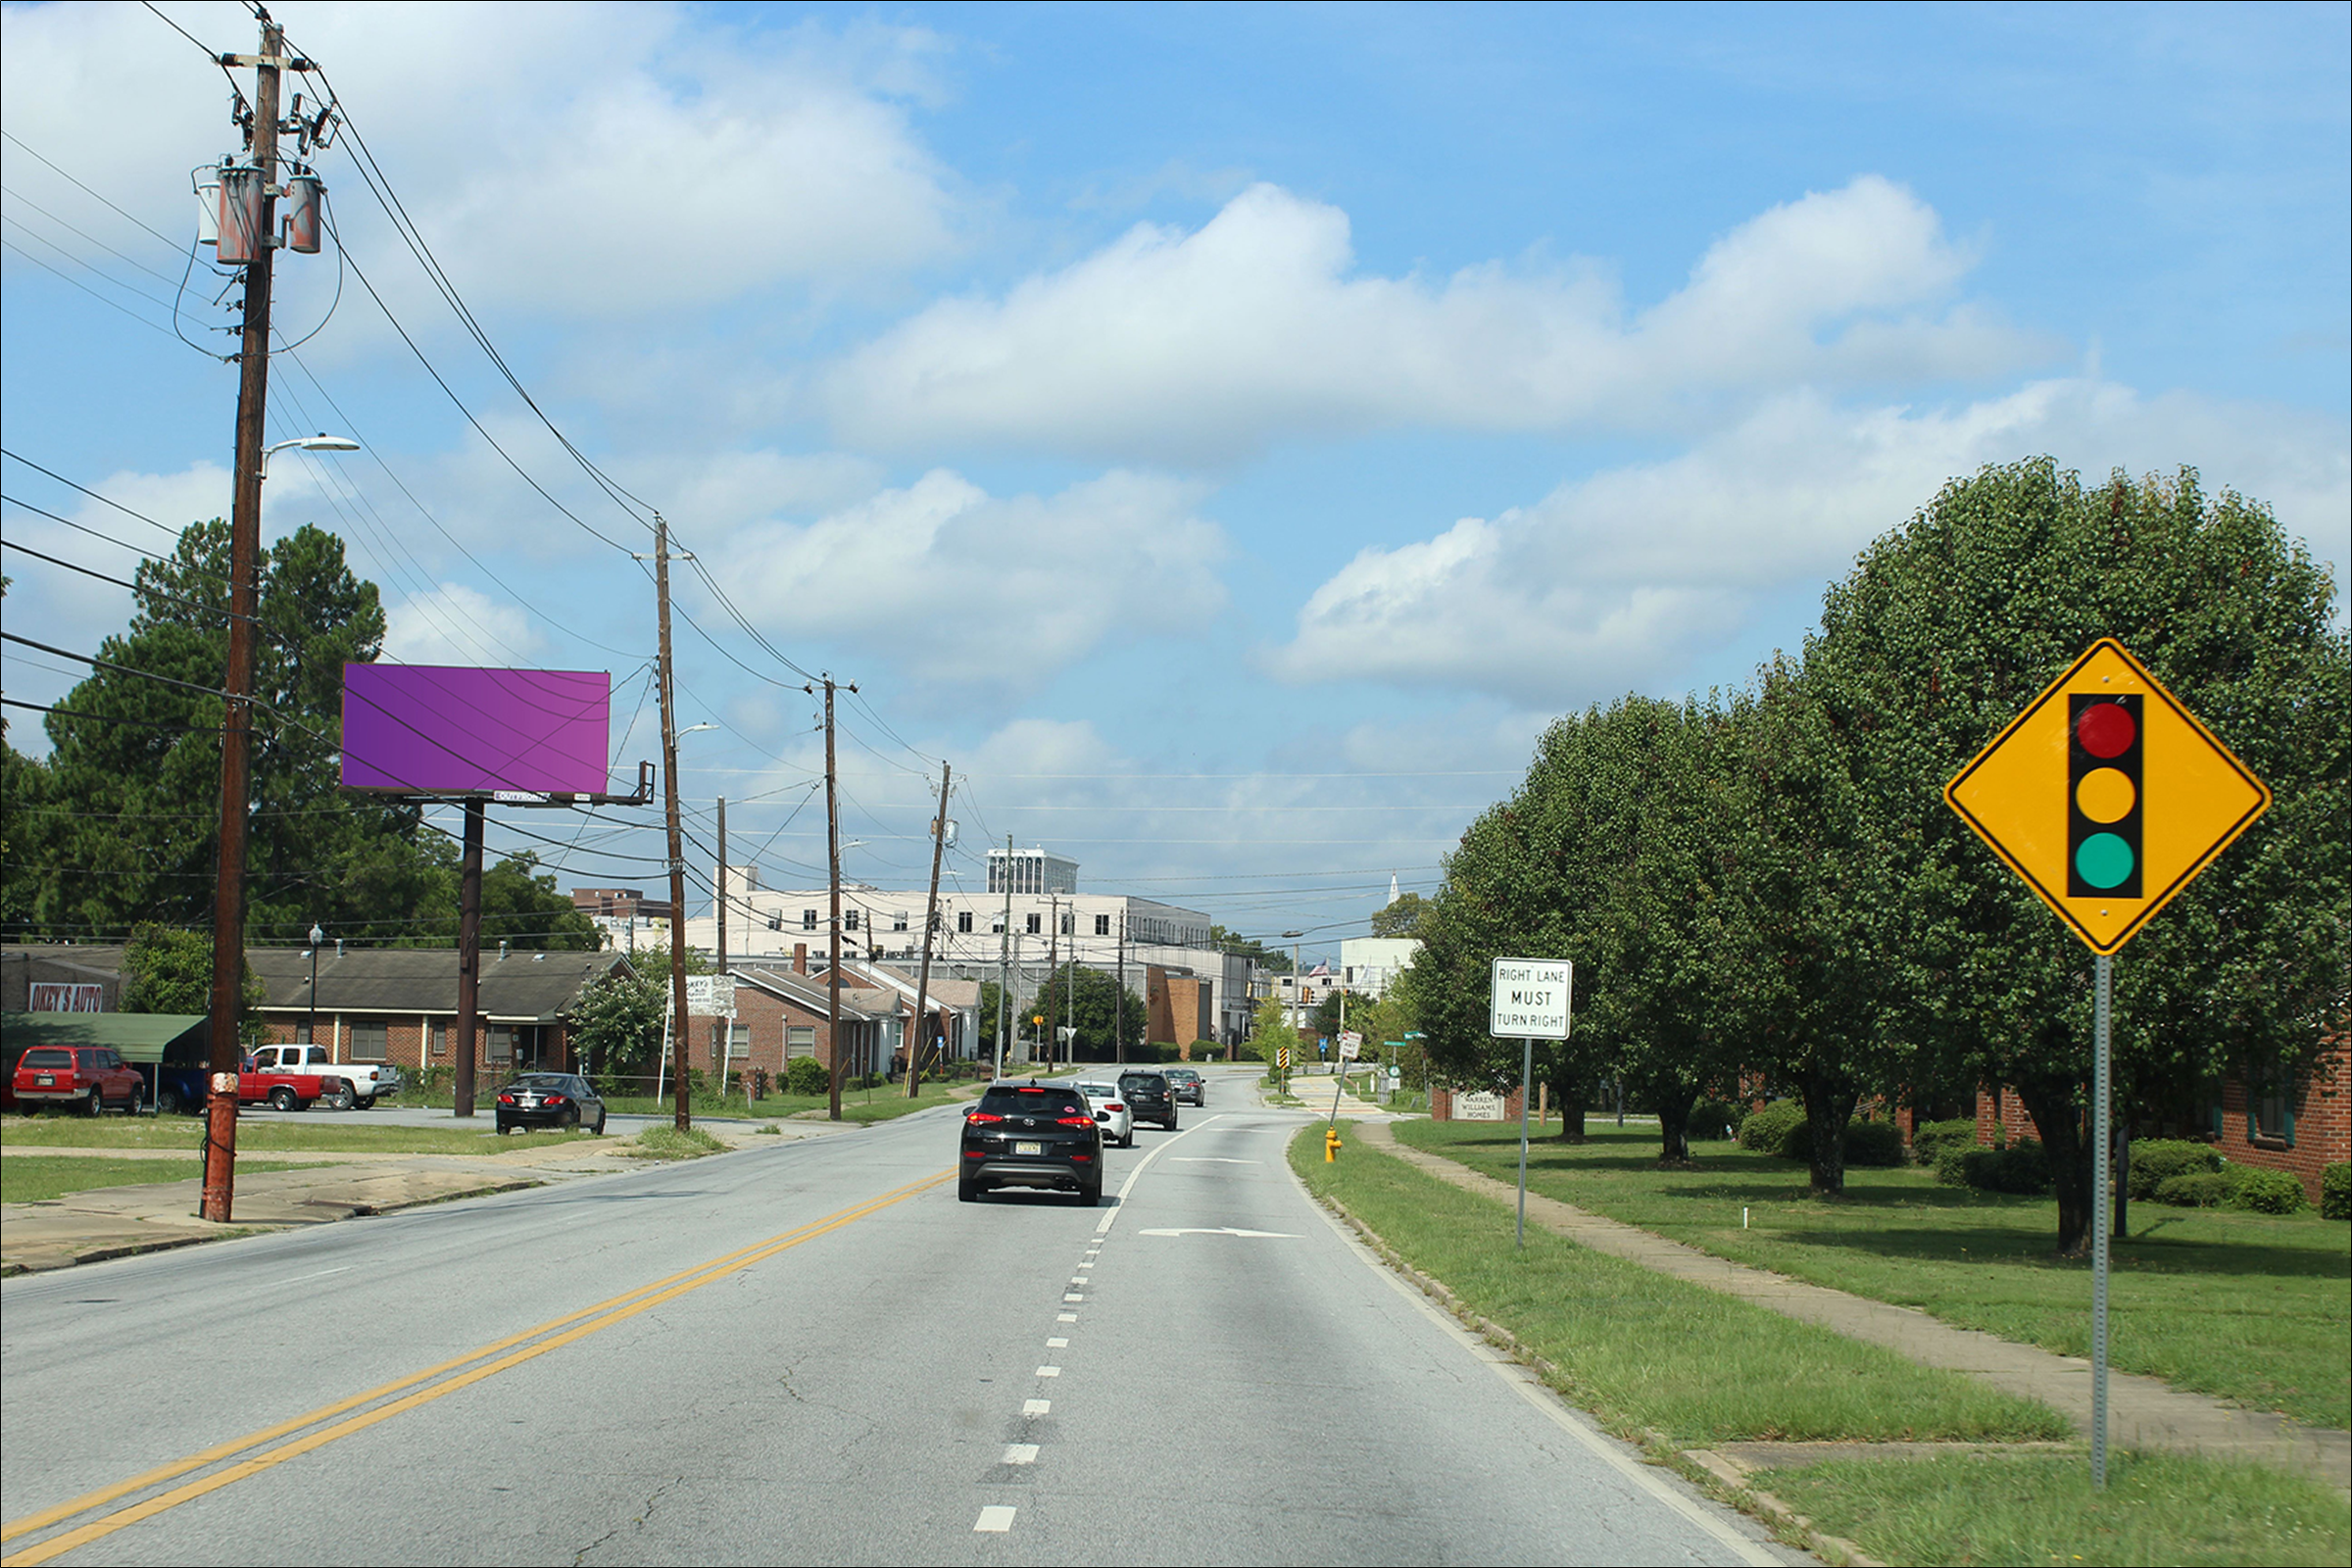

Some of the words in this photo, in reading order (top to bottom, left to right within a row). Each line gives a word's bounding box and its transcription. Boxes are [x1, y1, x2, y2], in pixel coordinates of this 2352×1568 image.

[1499, 968, 1531, 981] RIGHT
[1537, 970, 1565, 983] LANE
[32, 984, 72, 1011] OKEY'S
[73, 986, 101, 1012] AUTO
[1511, 990, 1551, 1005] MUST
[1497, 1012, 1527, 1026] TURN
[1530, 1014, 1564, 1027] RIGHT
